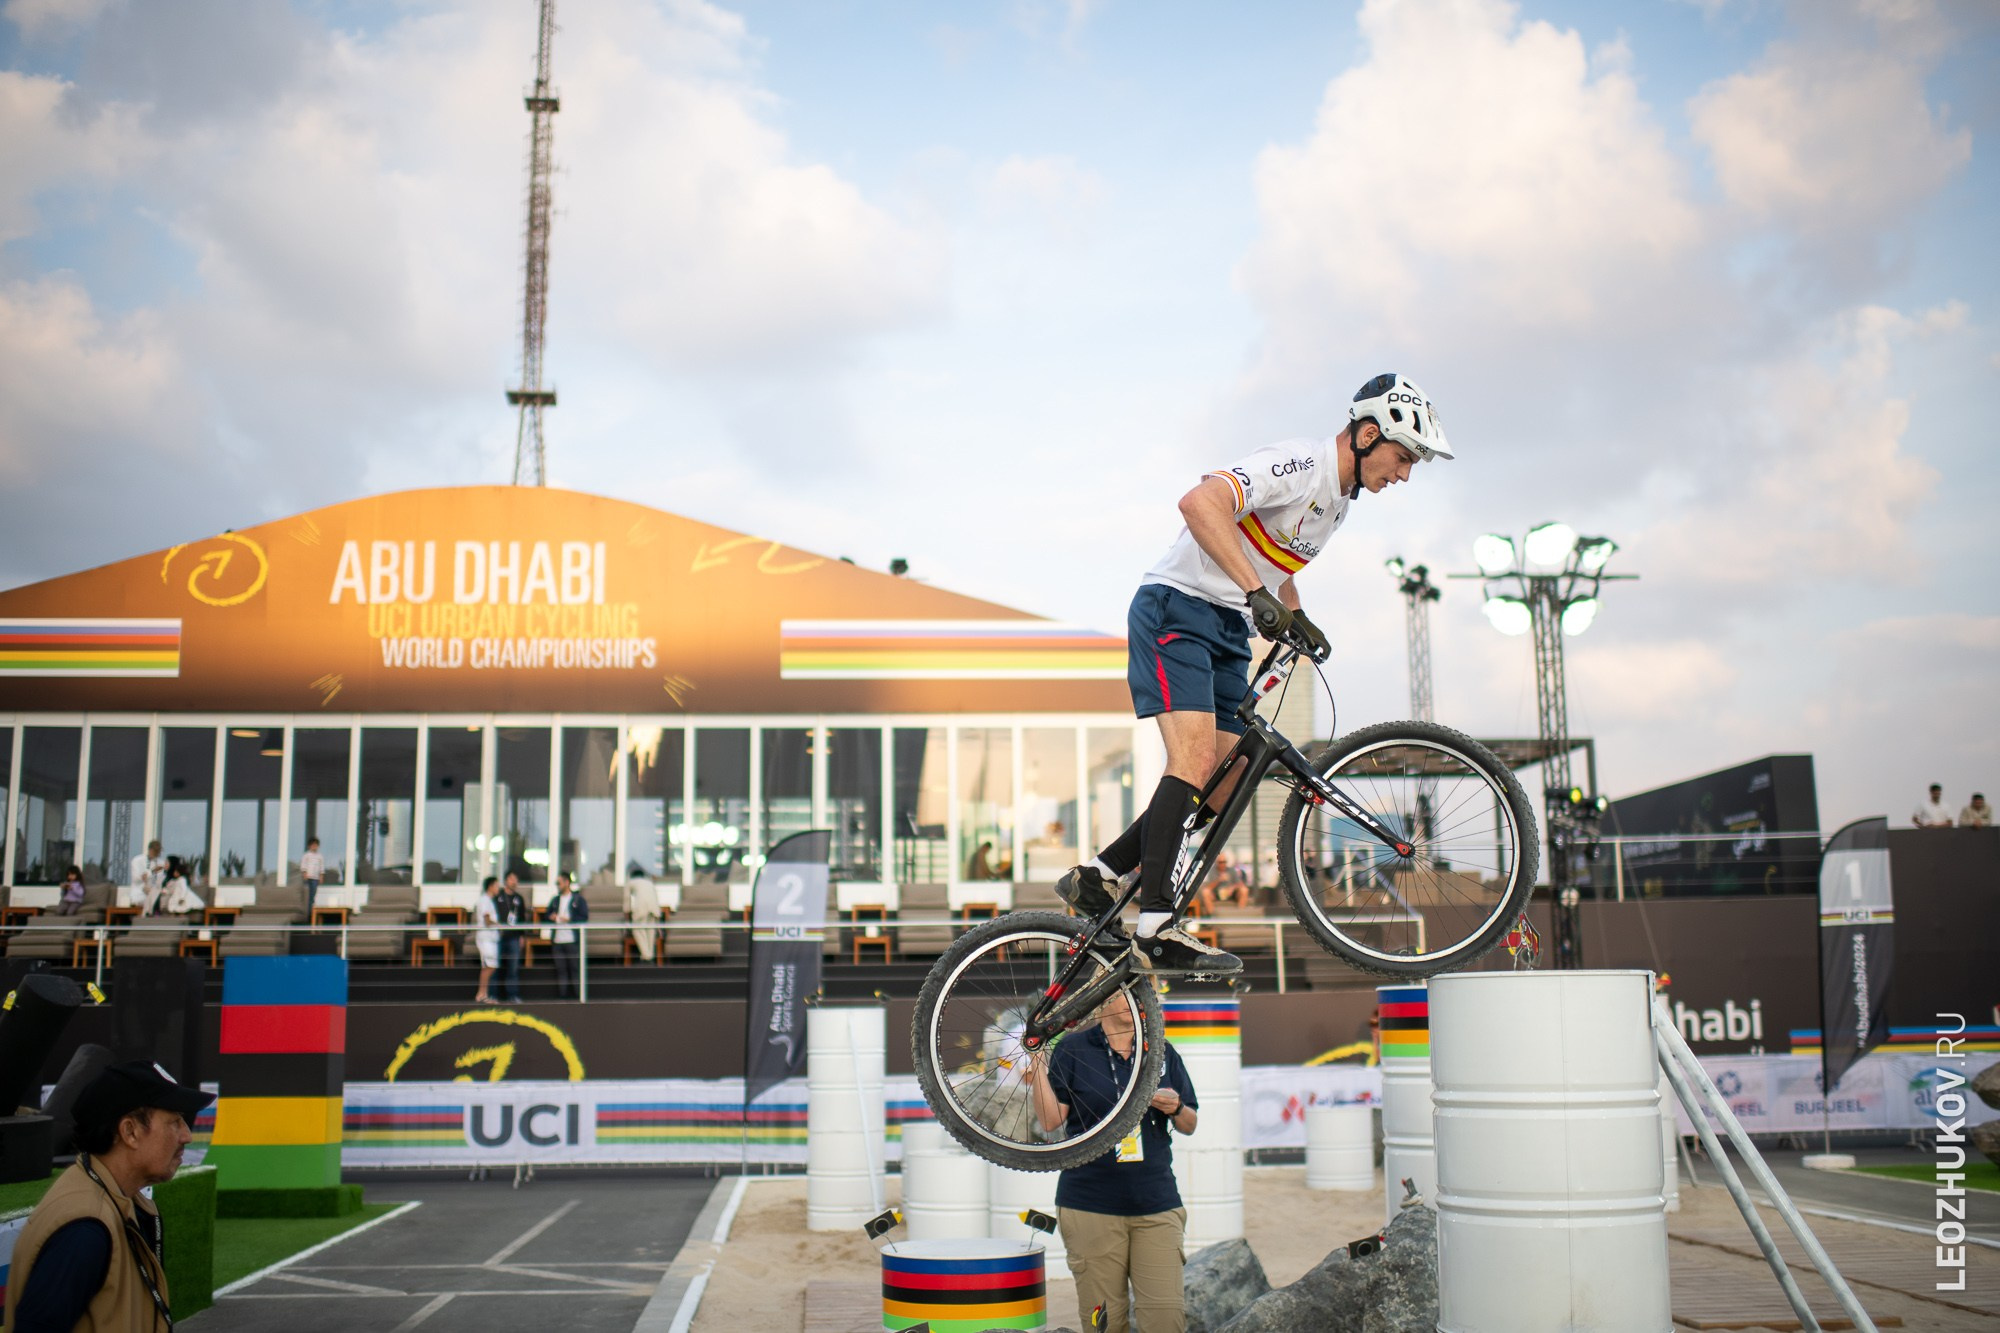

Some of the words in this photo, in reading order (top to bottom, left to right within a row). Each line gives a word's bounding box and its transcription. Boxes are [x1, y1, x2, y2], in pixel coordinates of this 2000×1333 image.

[329, 540, 436, 604] ABU
[453, 541, 606, 605] DHABI
[368, 603, 412, 638] UCI
[420, 603, 515, 639] URBAN
[525, 603, 639, 639] CYCLING
[381, 637, 464, 668] WORLD
[469, 637, 657, 669] CHAMPIONSHIPS
[777, 873, 804, 915] 2
[1845, 860, 1862, 900] 1
[775, 926, 801, 938] UCI
[1843, 910, 1870, 922] UCI
[771, 964, 785, 1003] Dhabi
[769, 1005, 782, 1033] Abu
[1669, 998, 1764, 1042] habi
[471, 1104, 579, 1147] UCI
